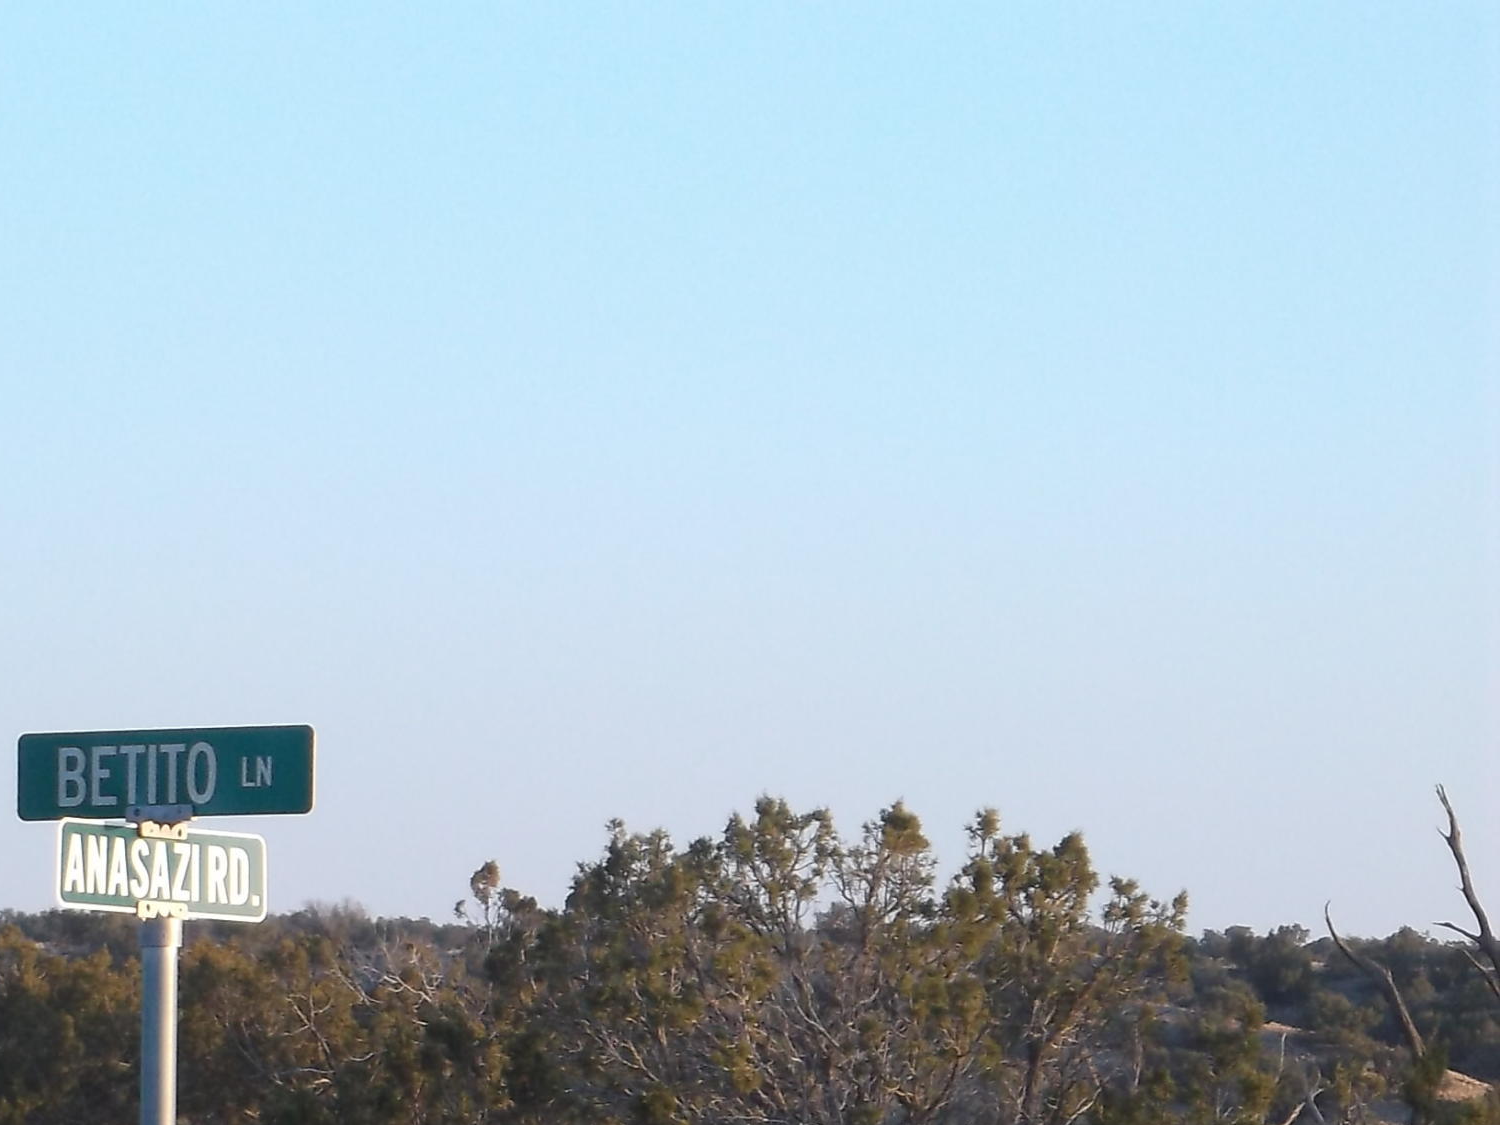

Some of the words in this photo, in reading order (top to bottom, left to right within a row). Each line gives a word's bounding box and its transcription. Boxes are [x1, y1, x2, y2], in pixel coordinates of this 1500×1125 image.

[57, 741, 217, 808] BETITO
[241, 756, 273, 788] LN
[63, 833, 201, 902] ANASAZI
[207, 845, 261, 907] RD.
